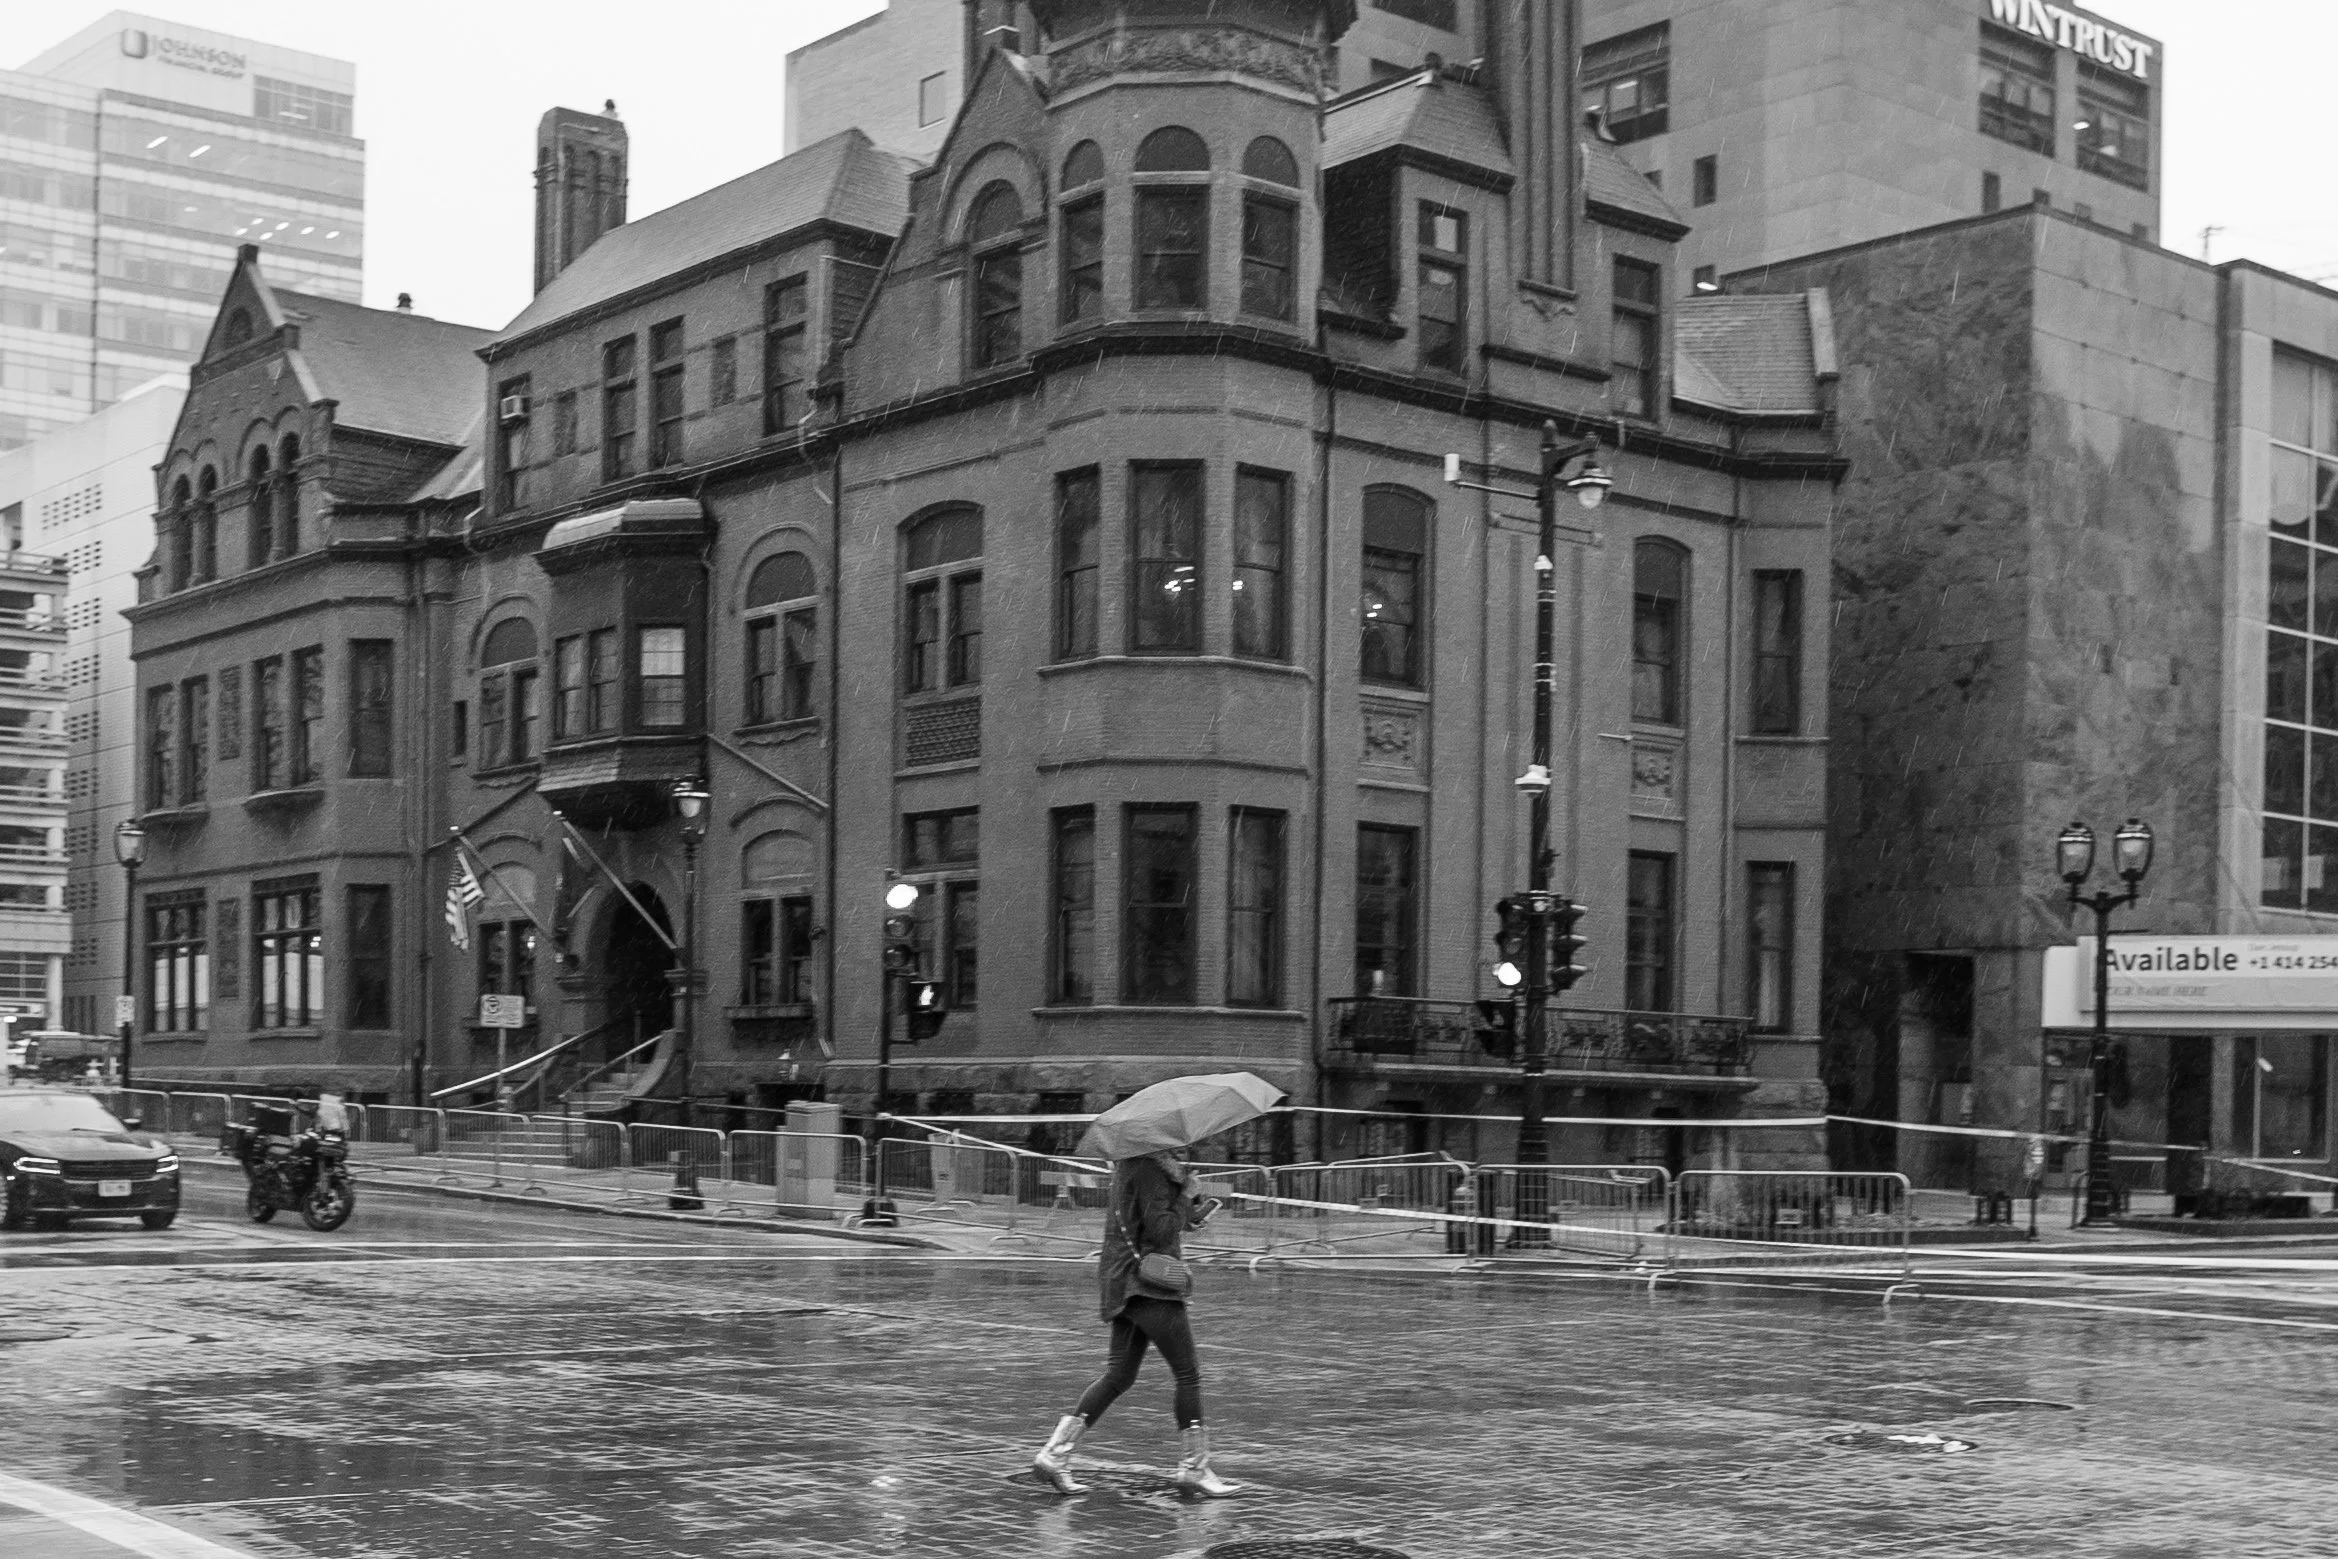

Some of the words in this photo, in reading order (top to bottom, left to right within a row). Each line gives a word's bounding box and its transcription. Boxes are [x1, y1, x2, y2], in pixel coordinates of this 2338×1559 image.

[150, 34, 245, 69] JOHNSON
[1989, 0, 2153, 78] WINTRUST
[2106, 946, 2239, 971] Available
[2249, 955, 2268, 969] +1
[2272, 955, 2304, 969] 414
